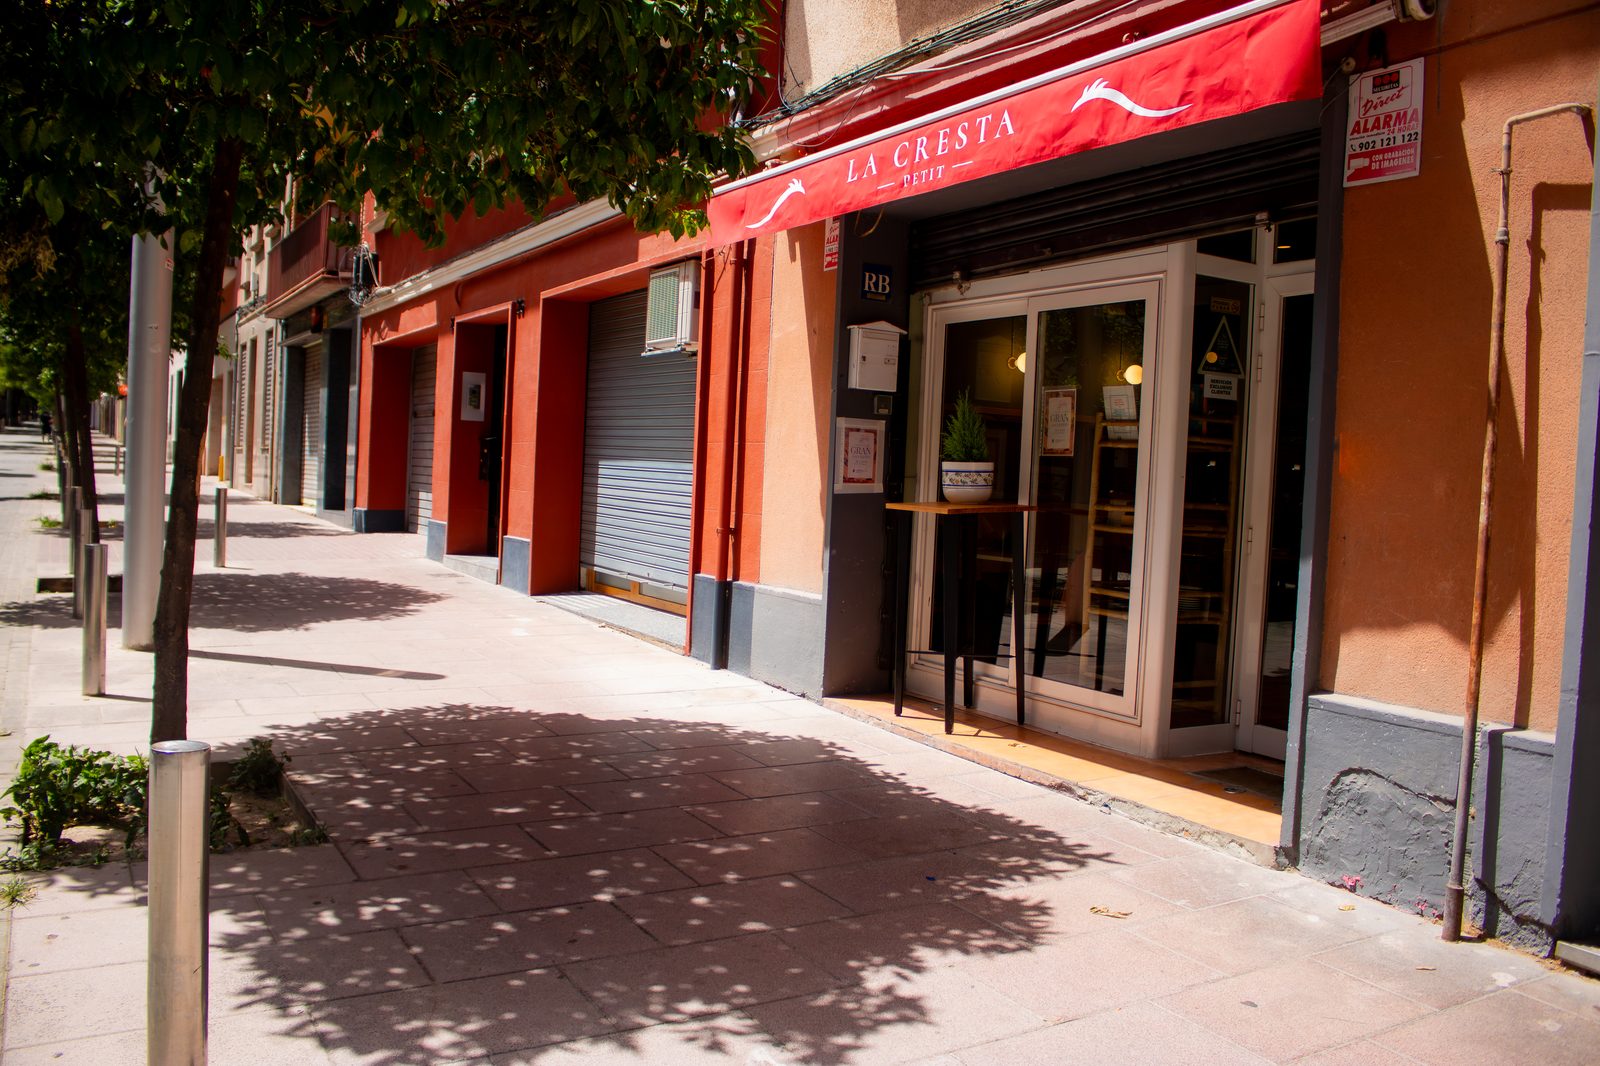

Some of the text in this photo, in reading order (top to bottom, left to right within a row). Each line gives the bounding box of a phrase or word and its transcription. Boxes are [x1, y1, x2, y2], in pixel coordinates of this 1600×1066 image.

[1361, 86, 1409, 116] Direct
[1350, 108, 1419, 136] ALARMA
[846, 109, 1015, 183] LA CRESTA
[1359, 140, 1376, 151] 902
[1381, 136, 1396, 147] 121
[1402, 131, 1419, 143] 122
[1371, 154, 1383, 162] CON
[1371, 155, 1414, 170] DE IMAGENES
[903, 165, 945, 187] PETIT
[863, 271, 890, 294] RB
